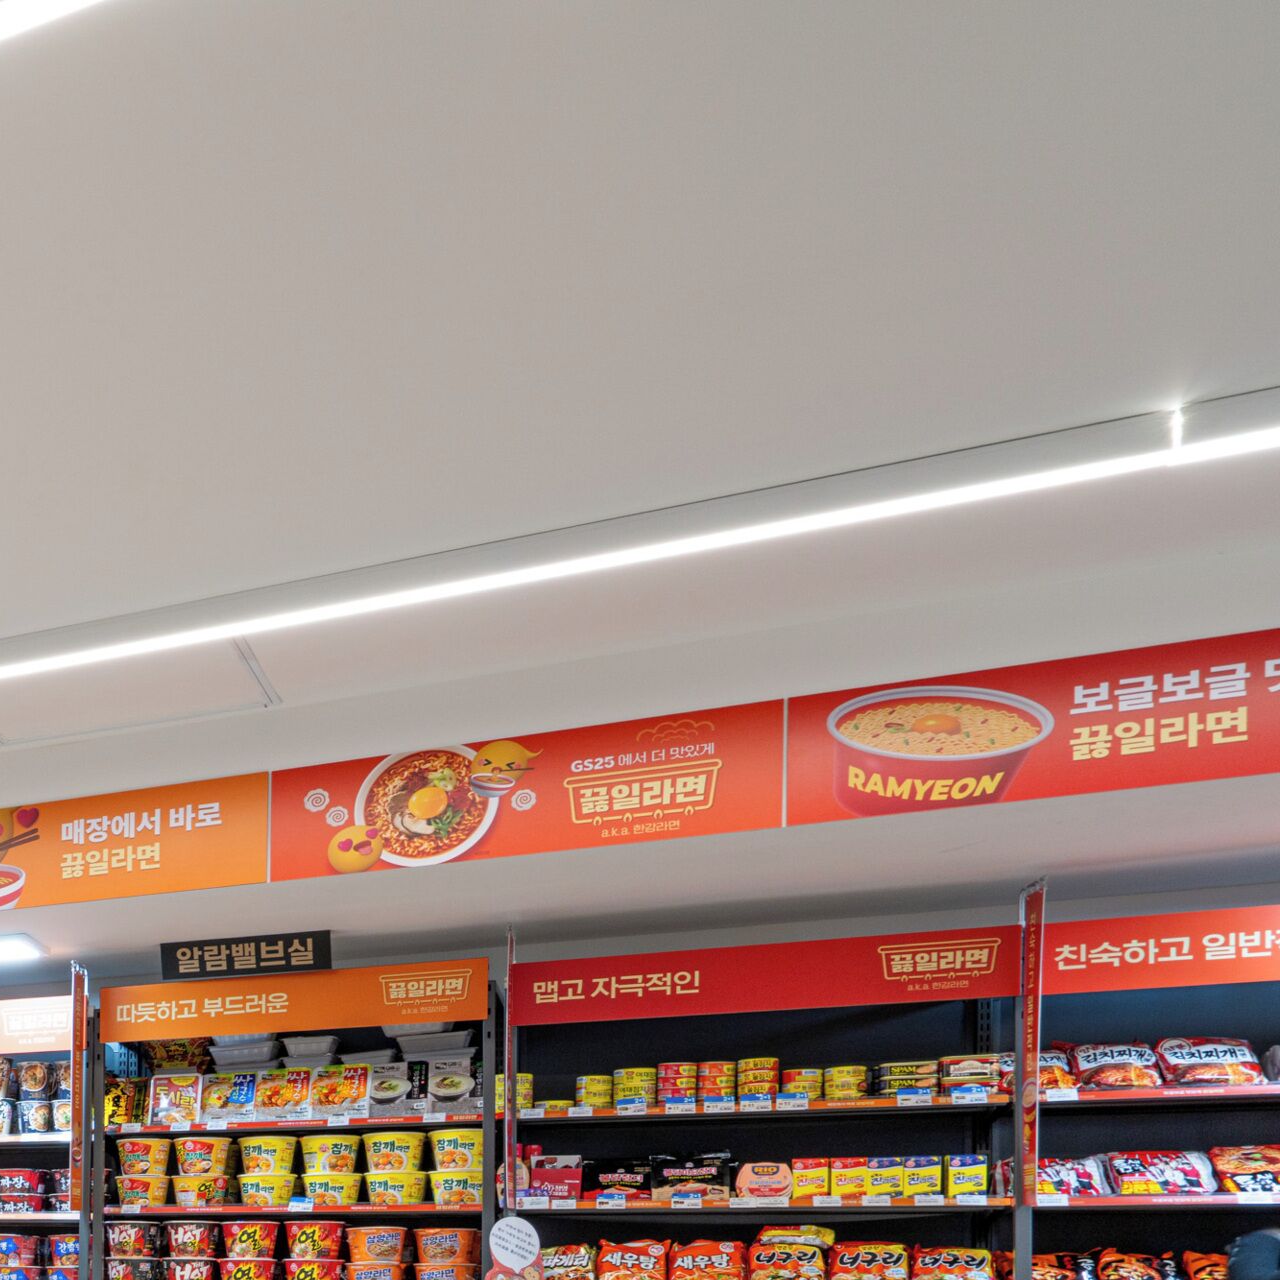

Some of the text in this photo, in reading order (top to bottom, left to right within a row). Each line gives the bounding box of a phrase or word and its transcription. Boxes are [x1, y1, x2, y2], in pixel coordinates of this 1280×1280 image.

[1070, 662, 1251, 718] 보글보글
[1070, 706, 1247, 761] 끓일라면
[571, 742, 714, 773] GS25 에서 더 맛있게
[579, 773, 708, 815] 끓일라면
[848, 765, 1004, 801] RAMYEON
[61, 802, 222, 845] 매장에서 바로
[61, 843, 160, 879] 끓일라면
[176, 938, 313, 973] 알람밸브실
[891, 948, 989, 972] 끓일라면
[1055, 937, 1193, 970] 친숙하고
[389, 976, 463, 998] 끓일라면
[533, 970, 700, 1003] 맵고 자극적인
[117, 993, 288, 1023] 따뜻하고 부드러운
[891, 1066, 916, 1074] SPAM
[1169, 1049, 1238, 1061] 김치찌개
[156, 1087, 195, 1109] 도시락
[602, 1252, 657, 1270] 새우탕
[674, 1253, 730, 1269] 새우탕
[755, 1250, 819, 1264] 너구리
[839, 1251, 904, 1267] 너구리
[920, 1253, 987, 1268] 너구리
